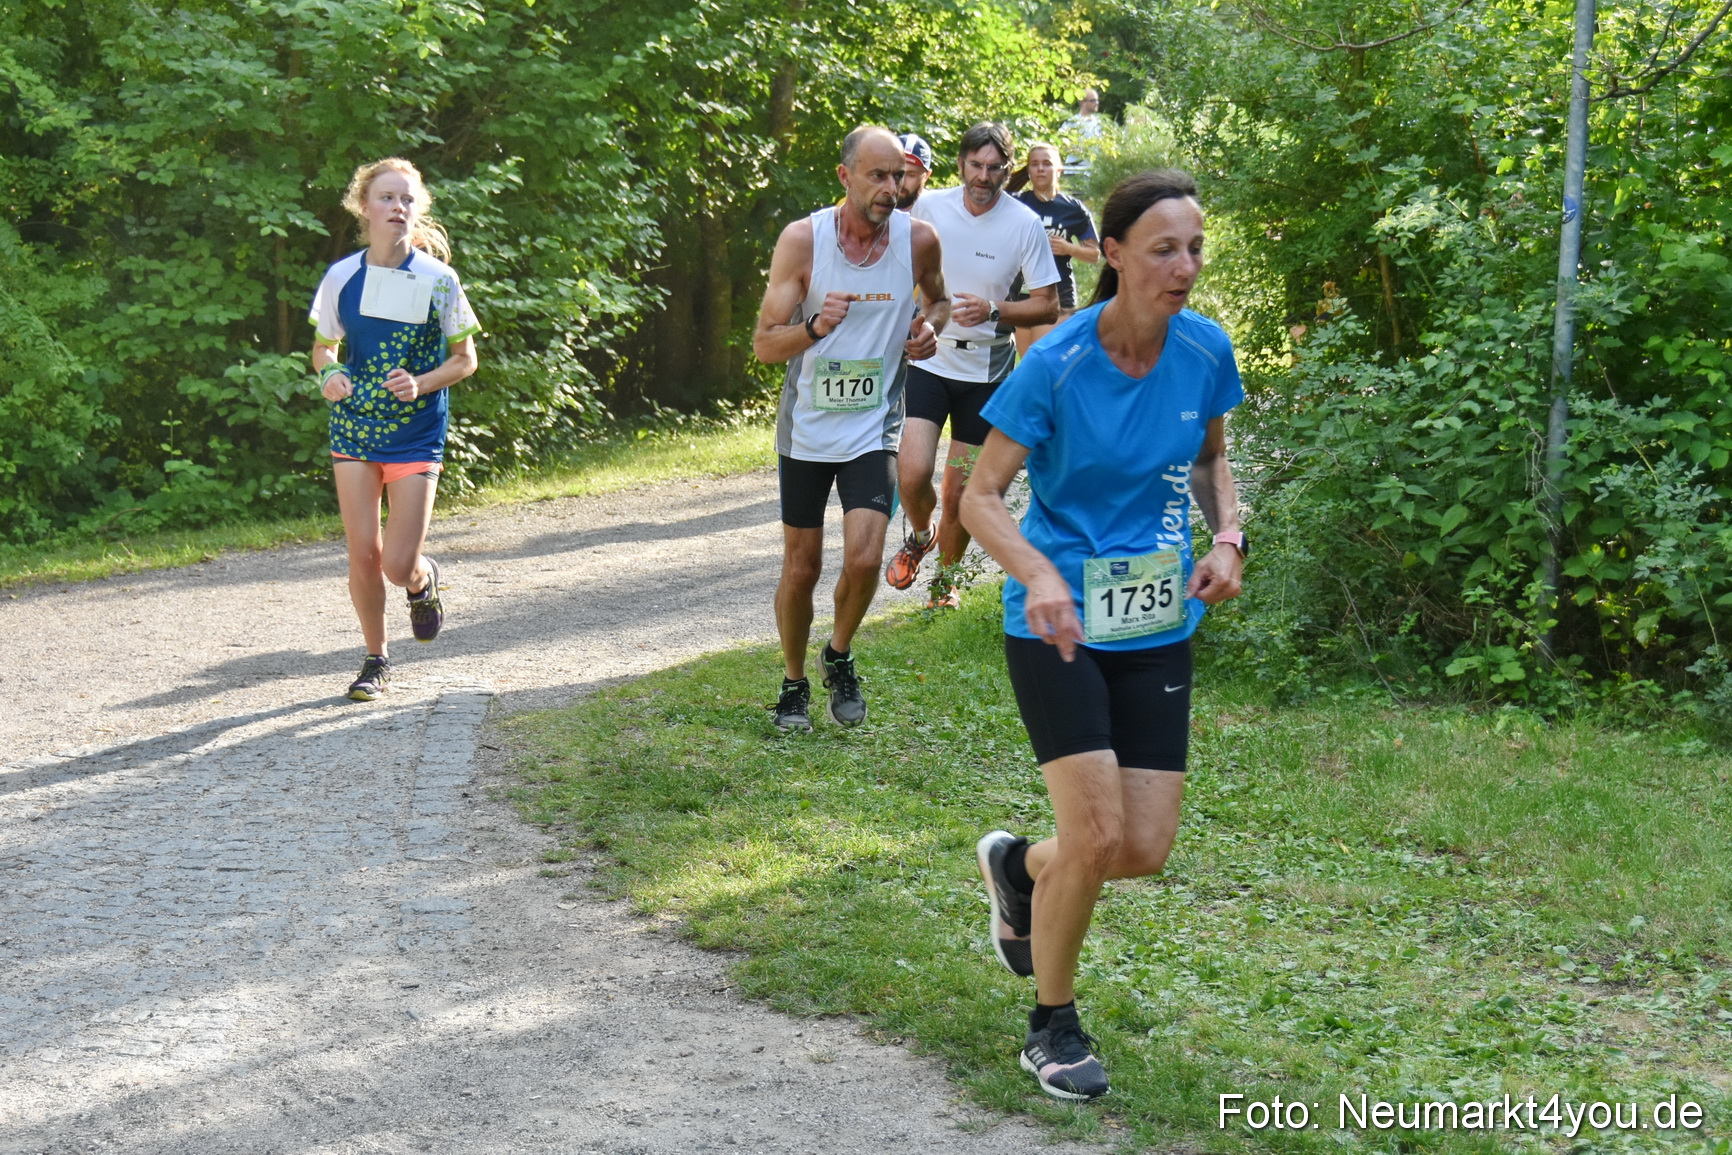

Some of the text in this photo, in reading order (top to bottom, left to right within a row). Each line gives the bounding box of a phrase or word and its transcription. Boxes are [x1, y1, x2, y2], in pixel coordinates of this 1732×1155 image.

[976, 251, 995, 260] Markus
[856, 293, 895, 302] LEBL
[822, 377, 874, 397] 1170
[1100, 578, 1173, 617] 1735
[1121, 616, 1140, 624] Marx
